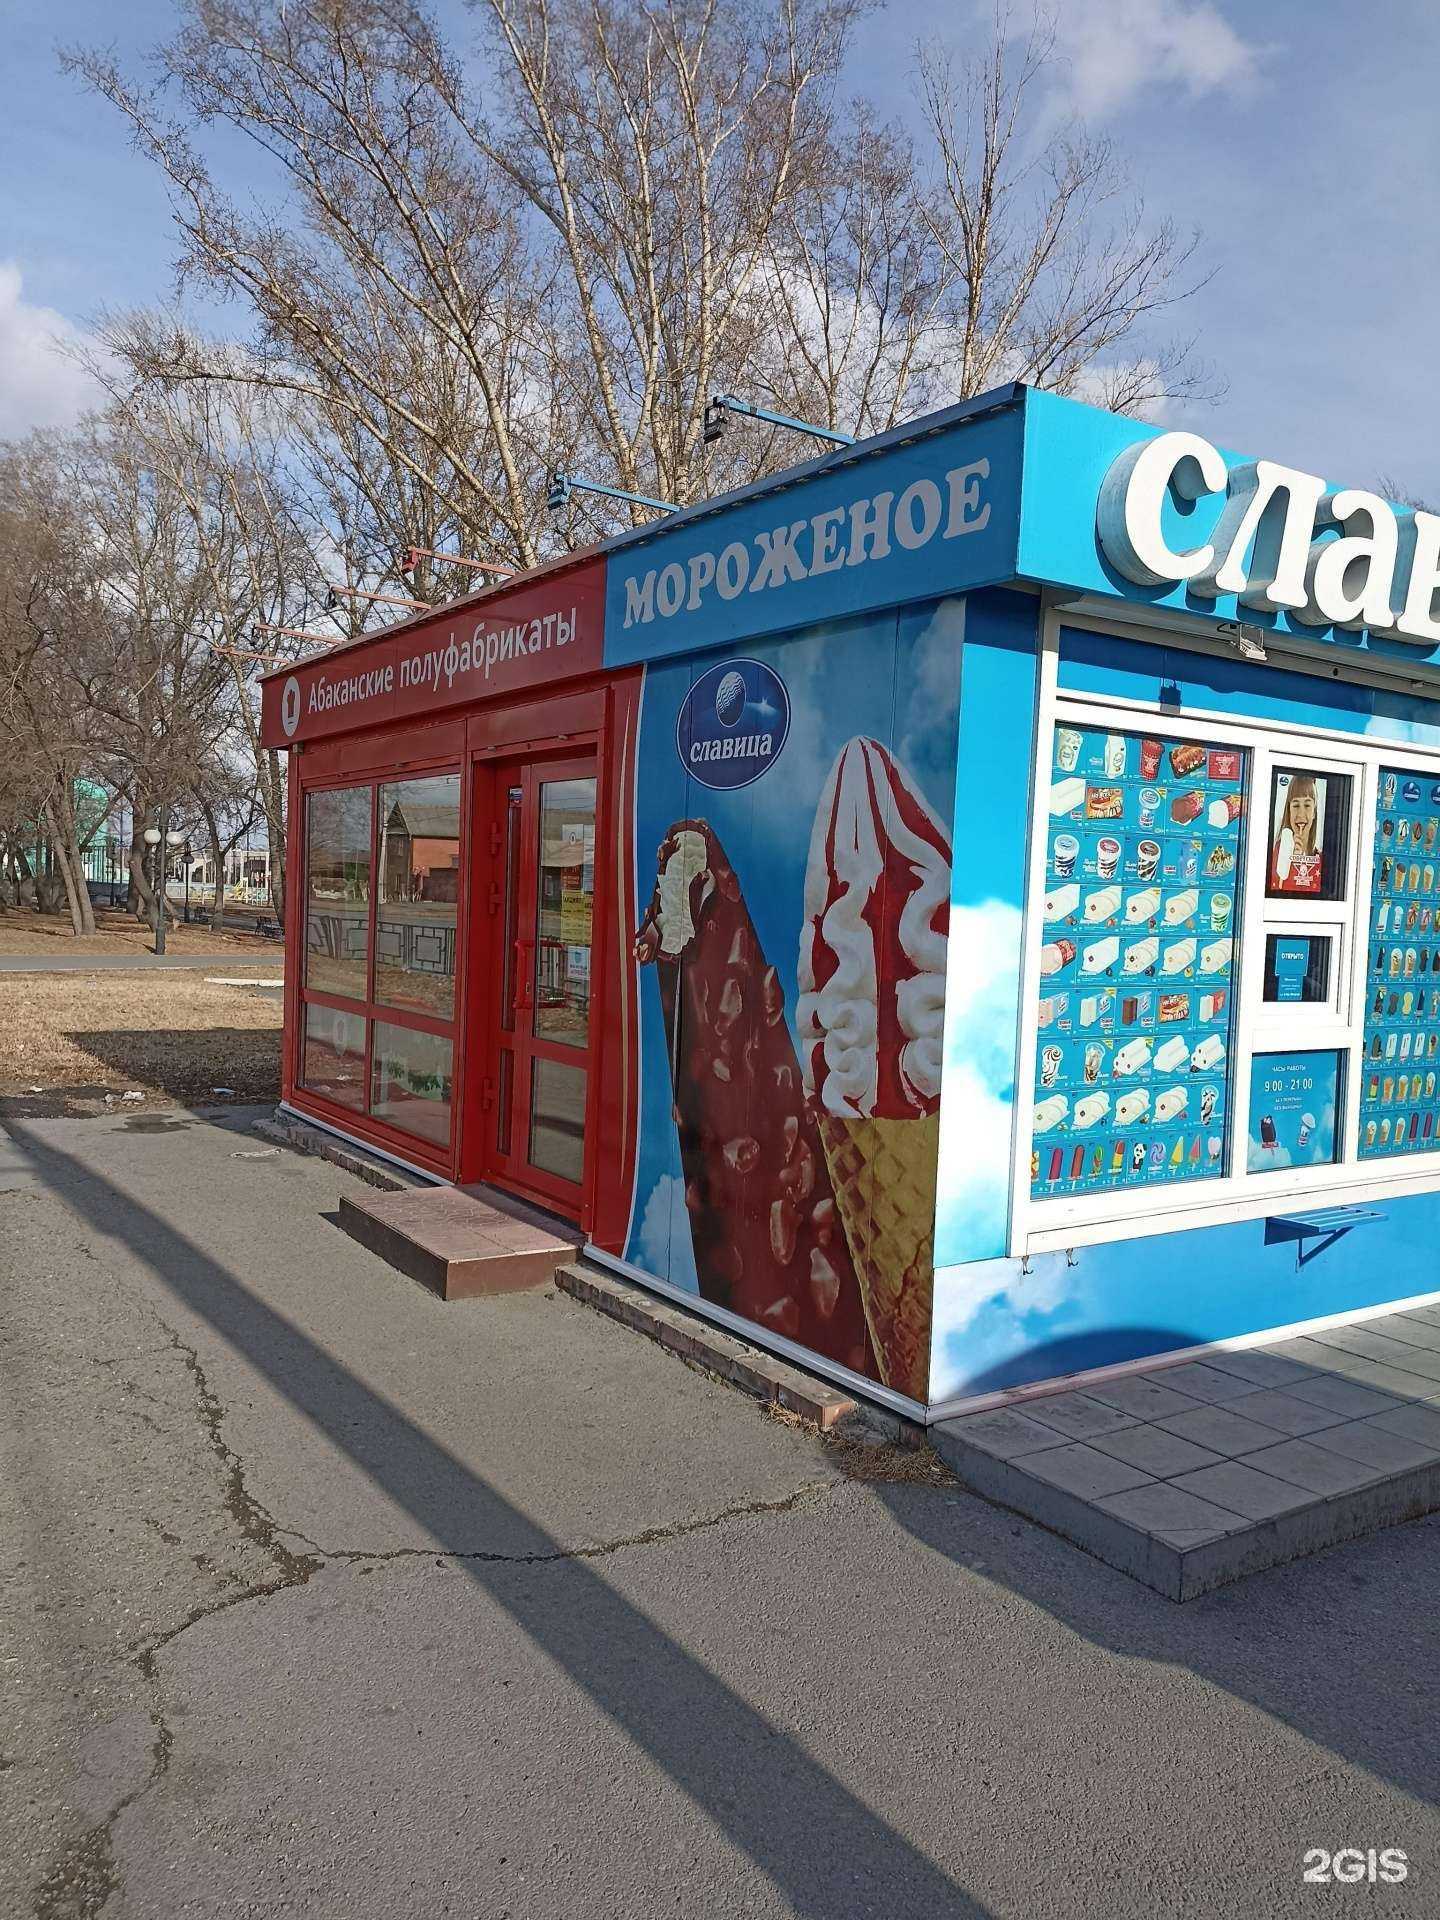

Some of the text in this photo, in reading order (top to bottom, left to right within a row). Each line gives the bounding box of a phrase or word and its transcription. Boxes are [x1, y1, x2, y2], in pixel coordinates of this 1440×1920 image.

[622, 458, 992, 629] МОРОЖЕНОЕ
[307, 607, 577, 714] Абаканские полуфабрикаты
[689, 732, 773, 764] славица
